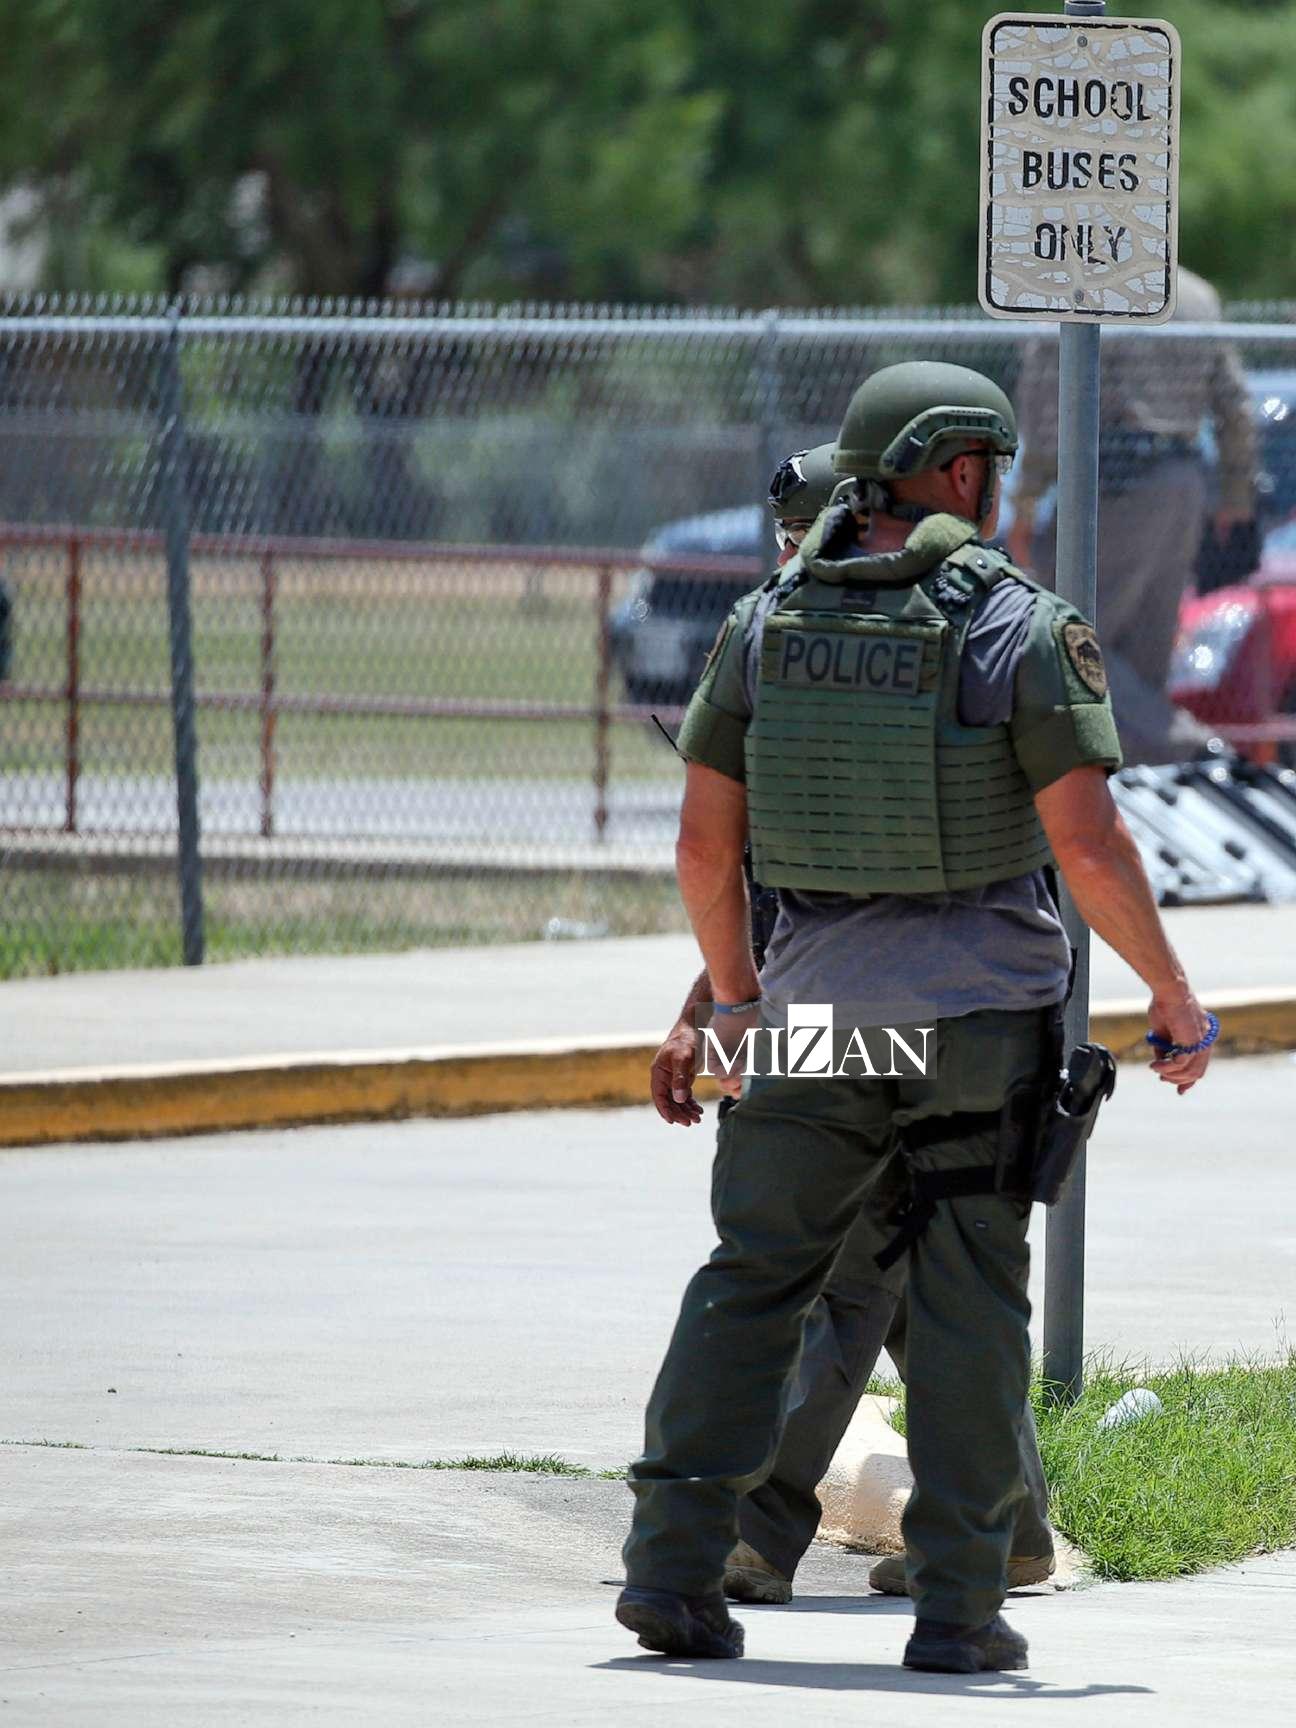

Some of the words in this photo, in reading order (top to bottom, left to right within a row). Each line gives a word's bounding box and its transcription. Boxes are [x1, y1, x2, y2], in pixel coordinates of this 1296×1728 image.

[1008, 77, 1152, 121] SCHOOL
[1022, 151, 1139, 192] BUSES
[1034, 223, 1127, 265] ONLY
[783, 635, 918, 688] POLICE
